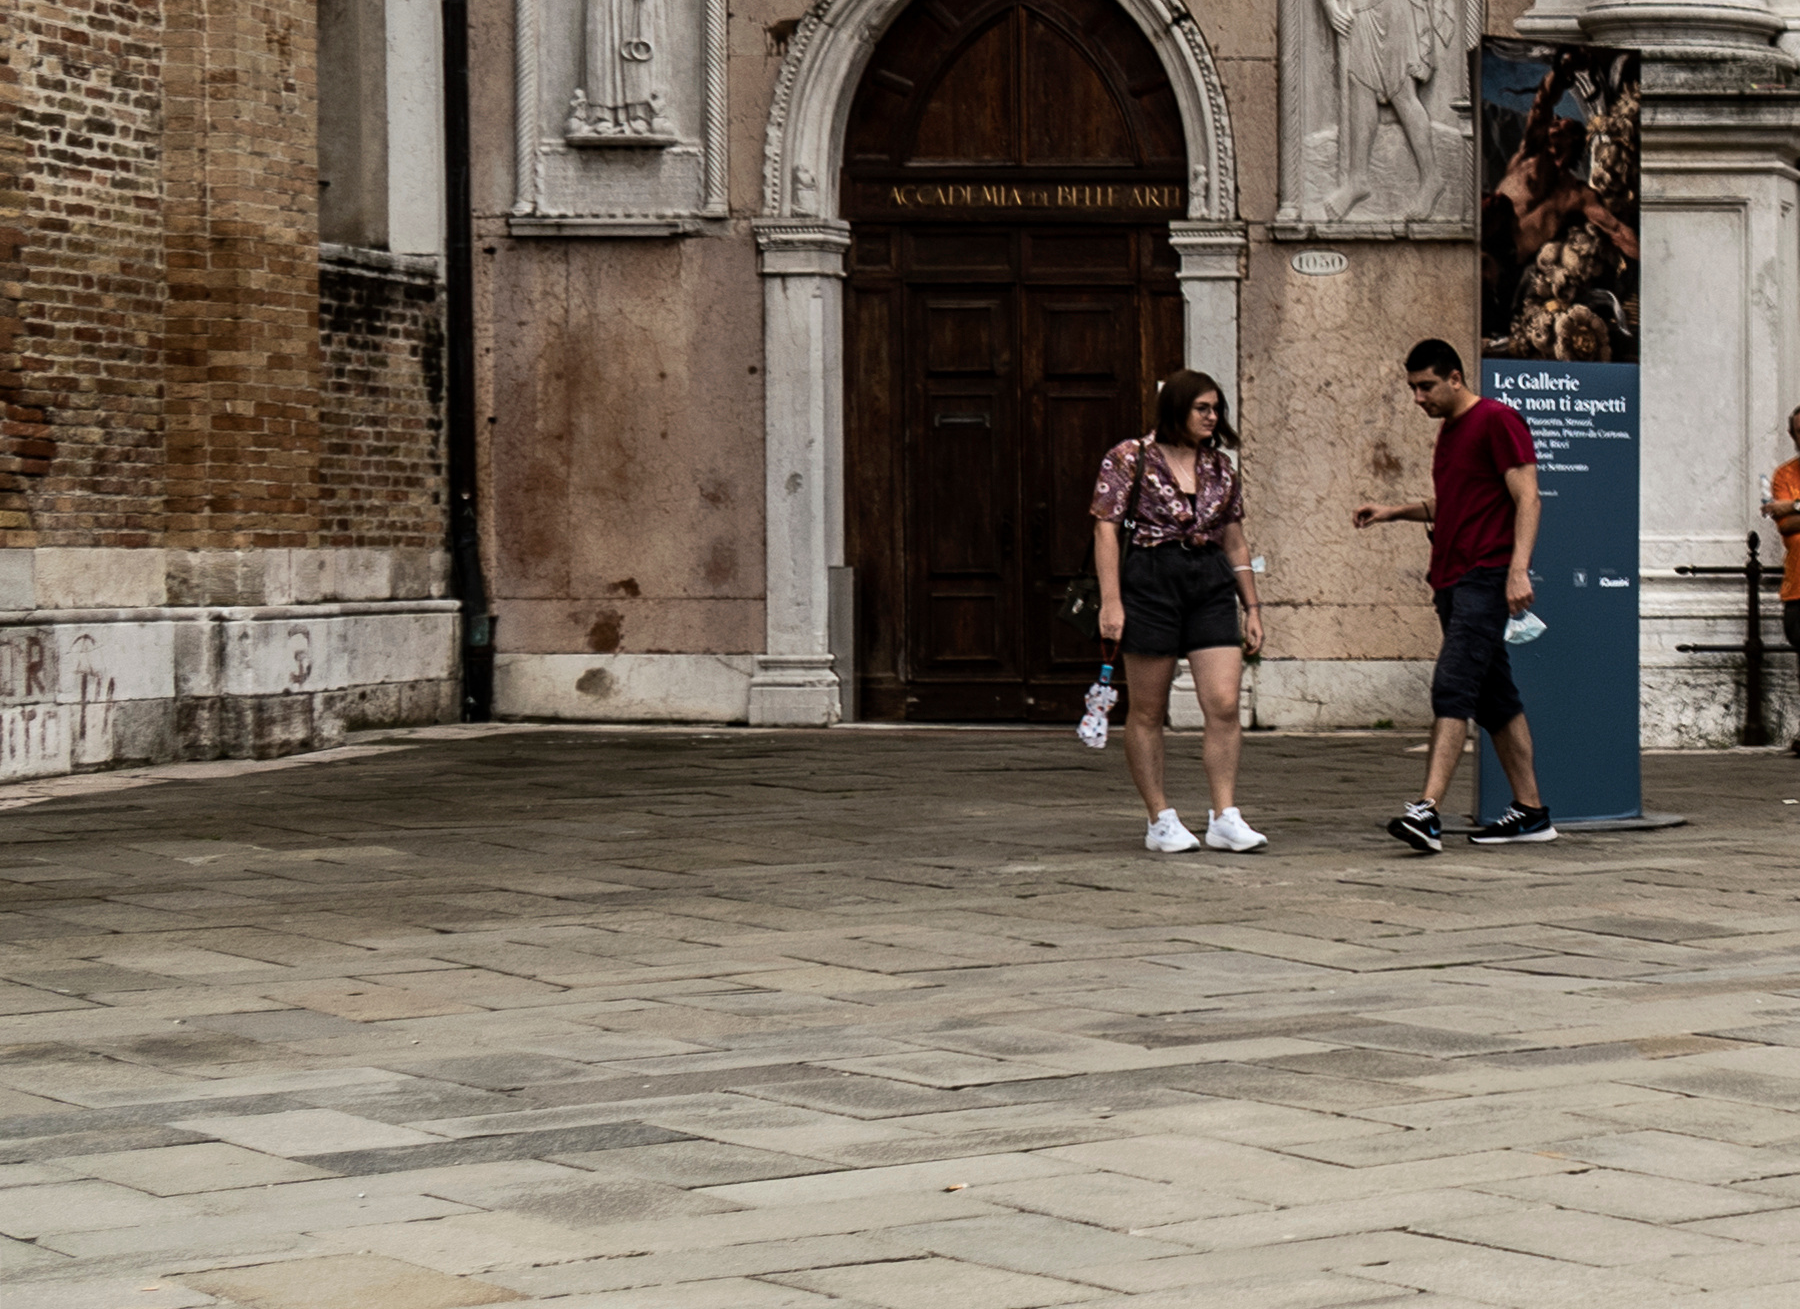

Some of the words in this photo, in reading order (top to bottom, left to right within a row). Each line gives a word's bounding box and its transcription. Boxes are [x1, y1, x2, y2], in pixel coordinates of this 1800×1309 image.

[888, 184, 1023, 207] ACCADEMIA
[1057, 184, 1121, 207] BELLE
[1130, 185, 1181, 208] ARTI
[1493, 371, 1515, 390] Le
[1517, 371, 1580, 392] Gallerie
[1525, 396, 1556, 412] non
[1559, 394, 1571, 412] ti
[1573, 395, 1627, 417] aspetti
